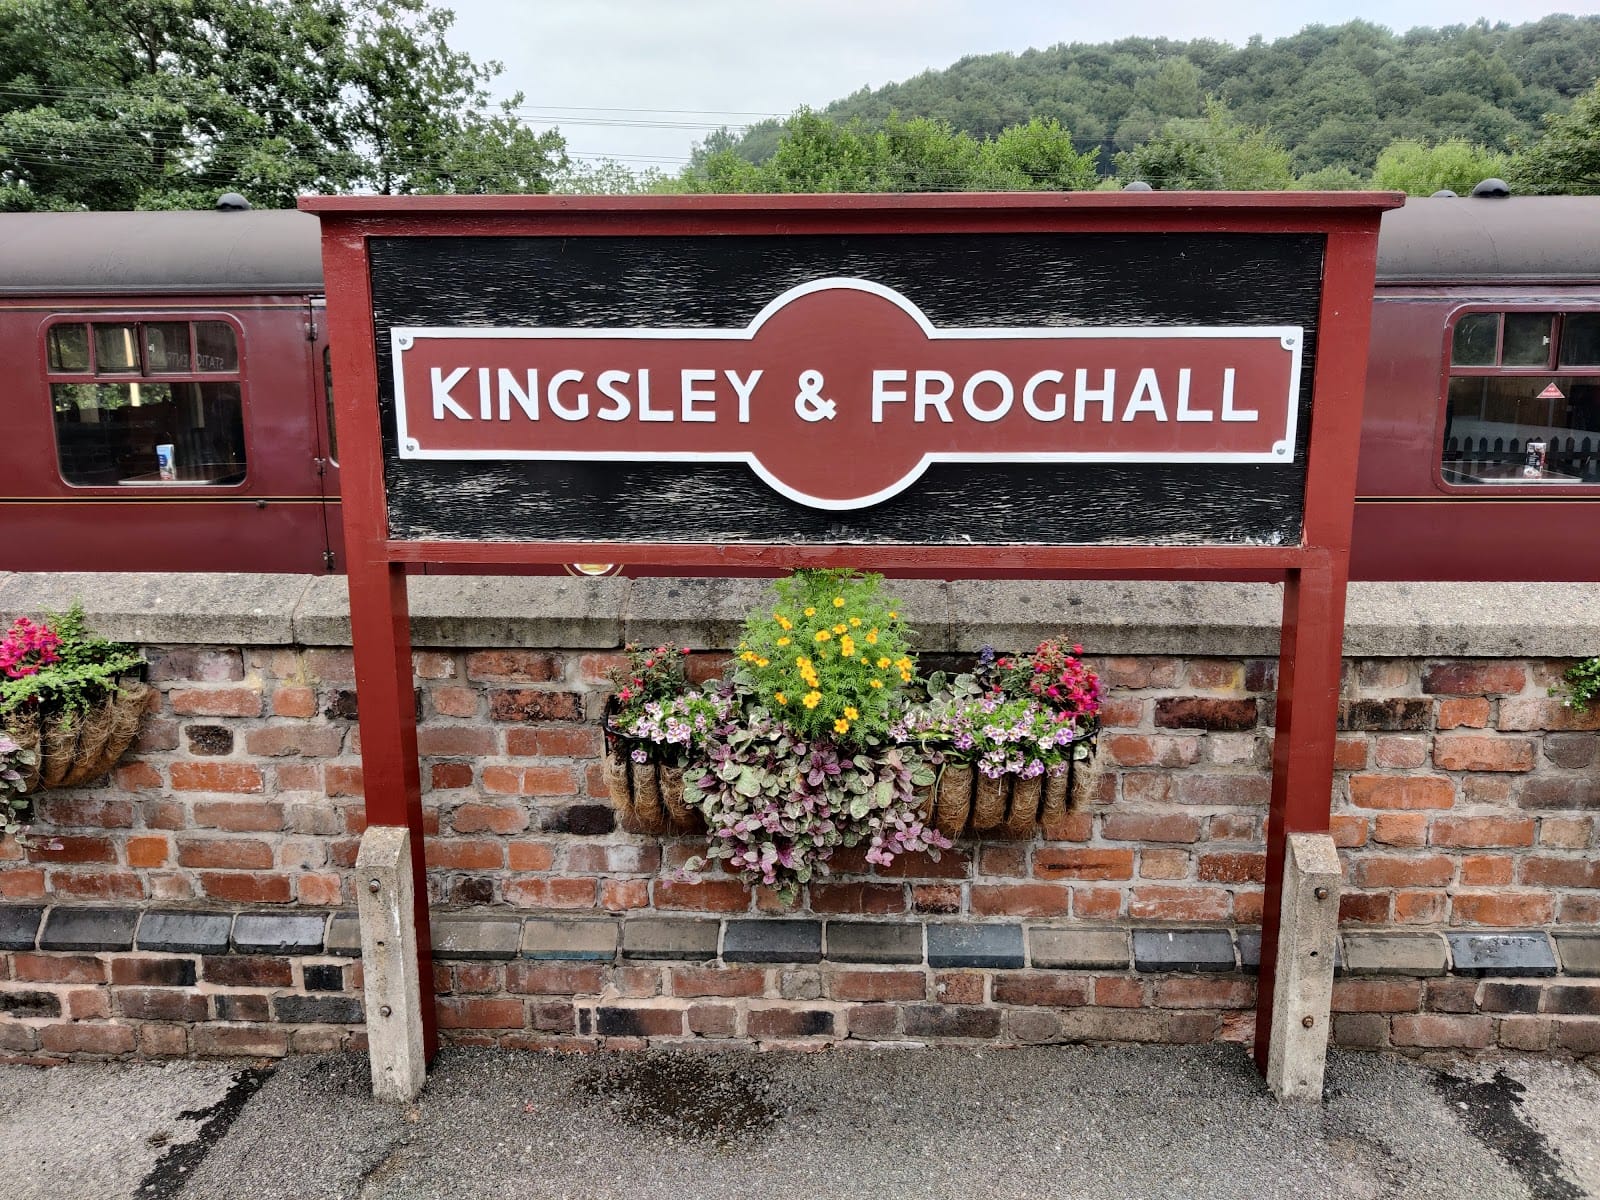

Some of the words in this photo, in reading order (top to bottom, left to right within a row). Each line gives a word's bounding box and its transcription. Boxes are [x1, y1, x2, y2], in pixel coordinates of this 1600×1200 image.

[430, 366, 764, 423] KINGSLEY
[794, 369, 837, 422] &
[871, 367, 1259, 423] FROGHALL
